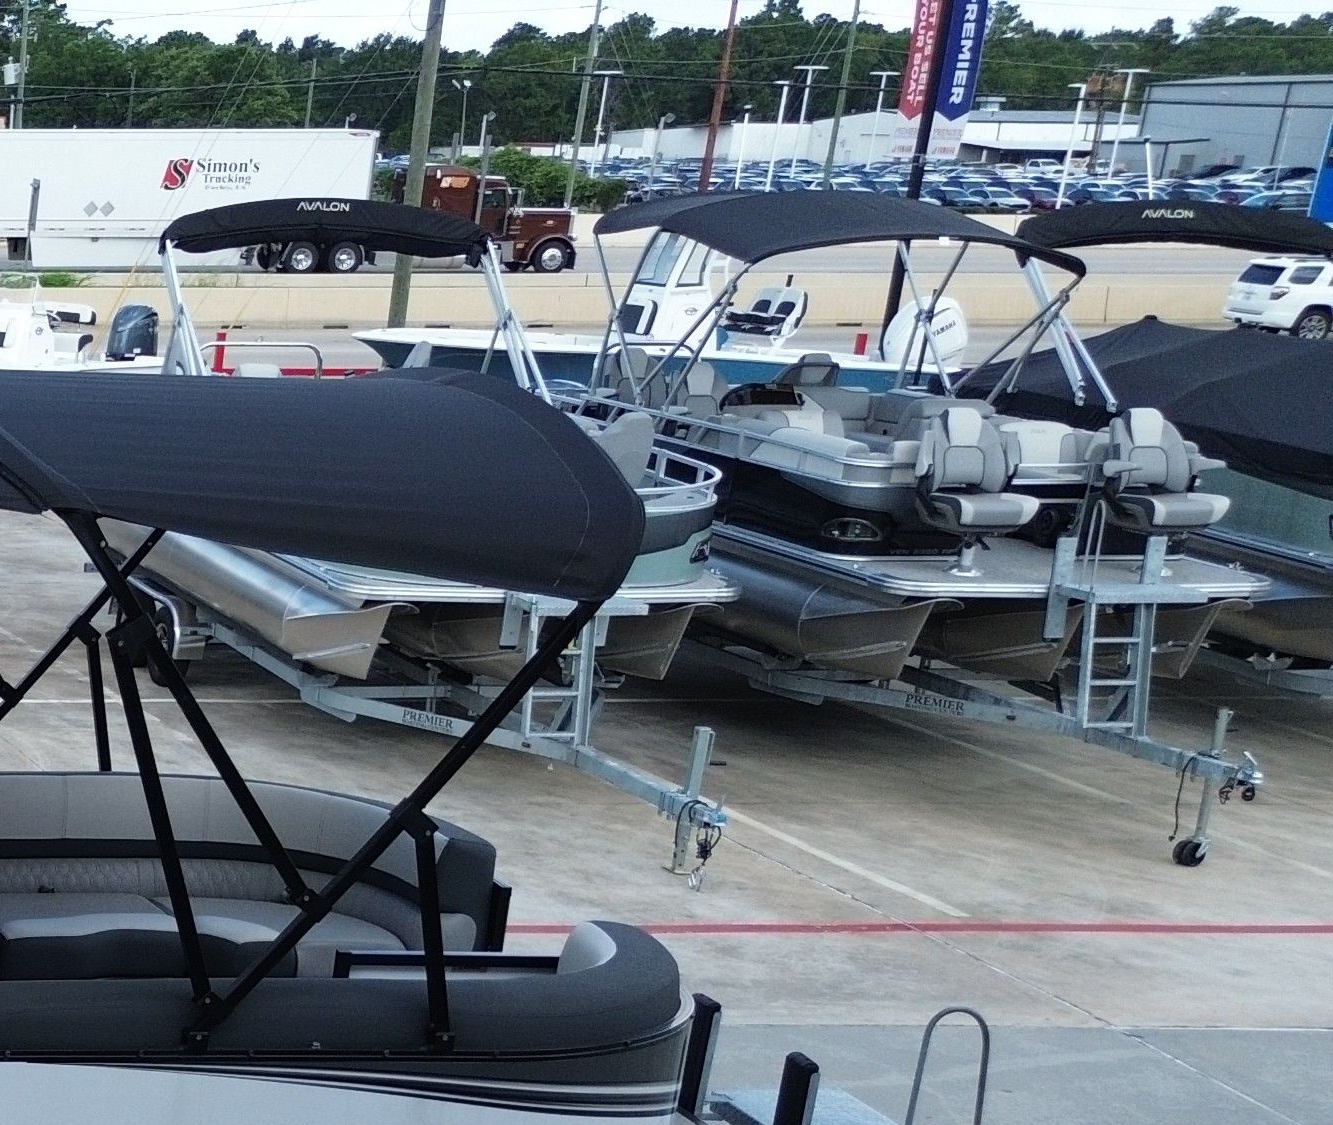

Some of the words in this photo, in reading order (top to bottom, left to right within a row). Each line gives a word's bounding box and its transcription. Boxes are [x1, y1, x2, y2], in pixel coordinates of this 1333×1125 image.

[948, 0, 979, 105] REMIER
[907, 53, 923, 104] BOAT
[913, 61, 929, 107] SELL
[196, 158, 261, 173] Simon's
[203, 174, 252, 185] Trucking
[296, 201, 351, 212] AVALON
[1141, 208, 1194, 219] AVALON
[906, 694, 965, 711] PREMIER
